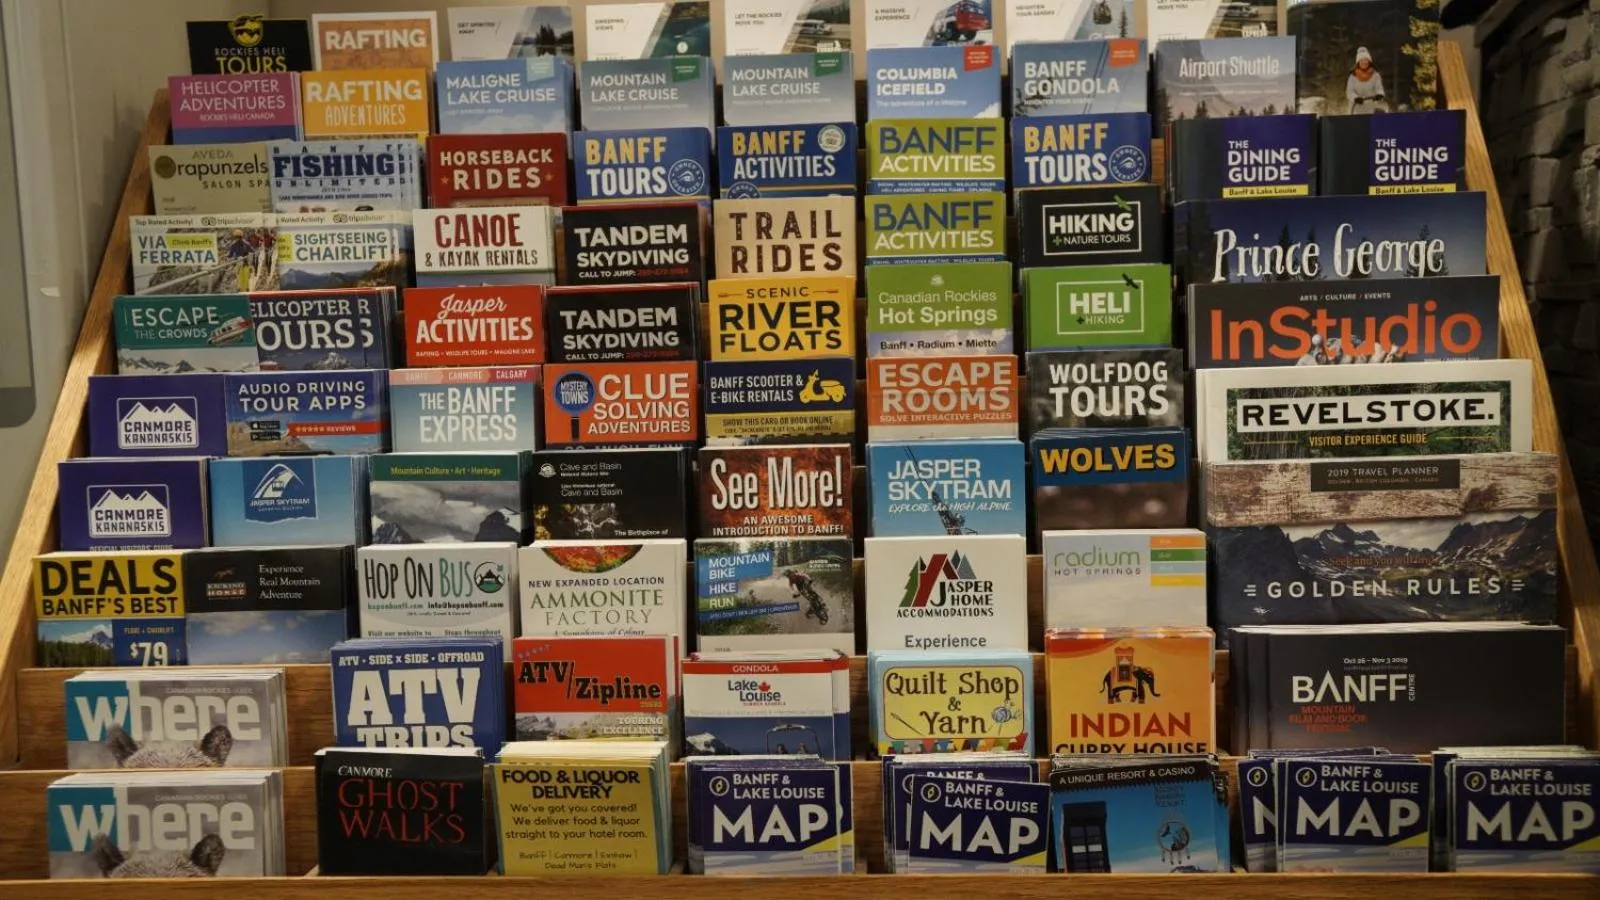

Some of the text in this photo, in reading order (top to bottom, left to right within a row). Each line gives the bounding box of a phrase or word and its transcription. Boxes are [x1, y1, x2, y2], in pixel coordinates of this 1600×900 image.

[325, 29, 427, 49] RAFTING
[216, 56, 288, 74] TOURS
[876, 68, 958, 80] COLUMBIA
[1024, 60, 1086, 78] BANFF
[1179, 56, 1279, 78] Airport Shuttle
[181, 80, 279, 96] HELICOPTER
[446, 73, 520, 88] MALIGNE
[591, 73, 666, 86] MOUNTAIN
[1024, 78, 1120, 96] GONDOLA
[306, 79, 422, 102] RAFTING
[448, 88, 556, 104] LAKE CRUISE
[591, 88, 678, 102] LAKE CRUISE
[877, 83, 946, 96] ICEFIELD
[179, 96, 286, 112] ADVENTURES
[326, 104, 405, 126] ADVENTURES
[732, 130, 805, 155] BANFF
[880, 127, 996, 153] BANFF
[1228, 140, 1248, 149] THE
[440, 148, 552, 166] HORSEBACK
[586, 136, 668, 165] BANFF
[1228, 148, 1300, 166] DINING
[177, 154, 268, 180] rapunzels
[273, 154, 394, 177] FISHING
[734, 155, 836, 180] ACTIVITIES
[879, 155, 996, 173] ACTIVITIES
[454, 168, 541, 190] RIDES
[586, 166, 668, 196] TOURS
[1228, 165, 1290, 182] GUIDE
[435, 214, 524, 248] CANOE
[729, 210, 842, 240] TRAIL
[1049, 212, 1134, 234] HIKING
[294, 231, 387, 246] SIGHTSEEING
[574, 224, 687, 247] TANDEM
[1064, 234, 1131, 244] NATURE TOURS
[140, 250, 215, 264] FERRATA
[296, 246, 388, 261] CHAIRLIFT
[425, 250, 538, 267] & KAYAK RENTALS
[576, 248, 689, 268] SKYDIVING
[731, 243, 842, 274] RIDES
[1212, 223, 1445, 282] Prince George
[746, 286, 809, 298] SCENIC
[879, 290, 997, 304] Canadian Rockies
[438, 294, 507, 320] Jasper
[1069, 292, 1130, 314] HELI
[131, 307, 220, 326] ESCAPE
[718, 300, 840, 330] RIVER
[879, 306, 998, 326] Hot Springs
[1086, 315, 1124, 325] HIKING
[135, 328, 208, 340] THE CROWDS
[416, 317, 533, 344] ACTIVITIES
[1209, 301, 1482, 361] InStudio
[720, 329, 842, 353] FLOATS
[710, 374, 804, 388] BANFF SCOOTER &
[880, 361, 1012, 387] ESCAPE
[1049, 362, 1168, 384] WOLFDOG
[238, 380, 365, 396] AUDIO DRIVING
[599, 373, 690, 400] CLUE
[240, 395, 366, 413] TOUR APPS
[419, 386, 516, 414] THE BANFF
[710, 390, 794, 403] E-BIKE RENTALS
[883, 386, 1010, 413] ROOMS
[1049, 385, 1169, 417] TOURS
[593, 401, 690, 419] SOLVING
[1242, 398, 1495, 427] REVELSTOKE.
[124, 421, 192, 432] CANMORE
[419, 414, 517, 443] EXPRESS
[588, 421, 690, 434] ADVENTURES
[124, 432, 193, 444] KANANASKIS
[1309, 433, 1428, 447] VISITOR EXPERIENCE GUIDE
[1040, 444, 1175, 474] WOLVES
[888, 459, 980, 480] JASPER
[1328, 466, 1439, 477] 2019 TRAVEL PLANNER
[711, 455, 843, 510] See More!
[888, 480, 1012, 501] SKYTRAM
[743, 515, 813, 525] AN AWESOME
[713, 524, 844, 536] INTRODUCTION TO BANFF!
[709, 553, 770, 568] MOUNTAIN
[1054, 546, 1140, 567] radium
[41, 558, 177, 596] DEALS
[258, 564, 304, 574] Experience
[364, 556, 473, 599] HOP ON BUS
[709, 568, 735, 580] BIKE
[259, 576, 320, 586] Real Mountain
[709, 583, 736, 595] HIKE
[1267, 577, 1502, 599] GOLDEN RULES
[260, 590, 303, 599] Adventure
[531, 589, 663, 609] AMMONITE
[709, 596, 735, 609] RUN
[951, 594, 993, 606] HOME
[42, 597, 178, 615] BANFF'S BEST
[897, 608, 994, 618] ACCOMMODATIONS
[545, 609, 652, 626] FACTORY
[905, 635, 986, 650] Experience
[728, 679, 758, 692] Lake
[886, 671, 1019, 703] Quilt Shop
[348, 667, 480, 725] ATV
[739, 690, 781, 702] Louise
[948, 697, 960, 711] &
[76, 681, 261, 741] where
[920, 711, 987, 735] Yarn
[1070, 712, 1191, 738] INDIAN
[337, 765, 393, 778] CANMORE
[503, 770, 640, 785] FOOD & LIQUOR
[733, 774, 791, 785] BANFF &
[1321, 766, 1383, 778] BANFF &
[338, 779, 464, 809] GHOST
[532, 786, 612, 799] DELIVERY
[733, 788, 825, 799] LAKE LOUISE
[1321, 780, 1419, 793] LAKE LOUISE
[713, 804, 829, 843] MAP
[1296, 796, 1420, 837] MAP
[339, 809, 465, 843] WALKS
